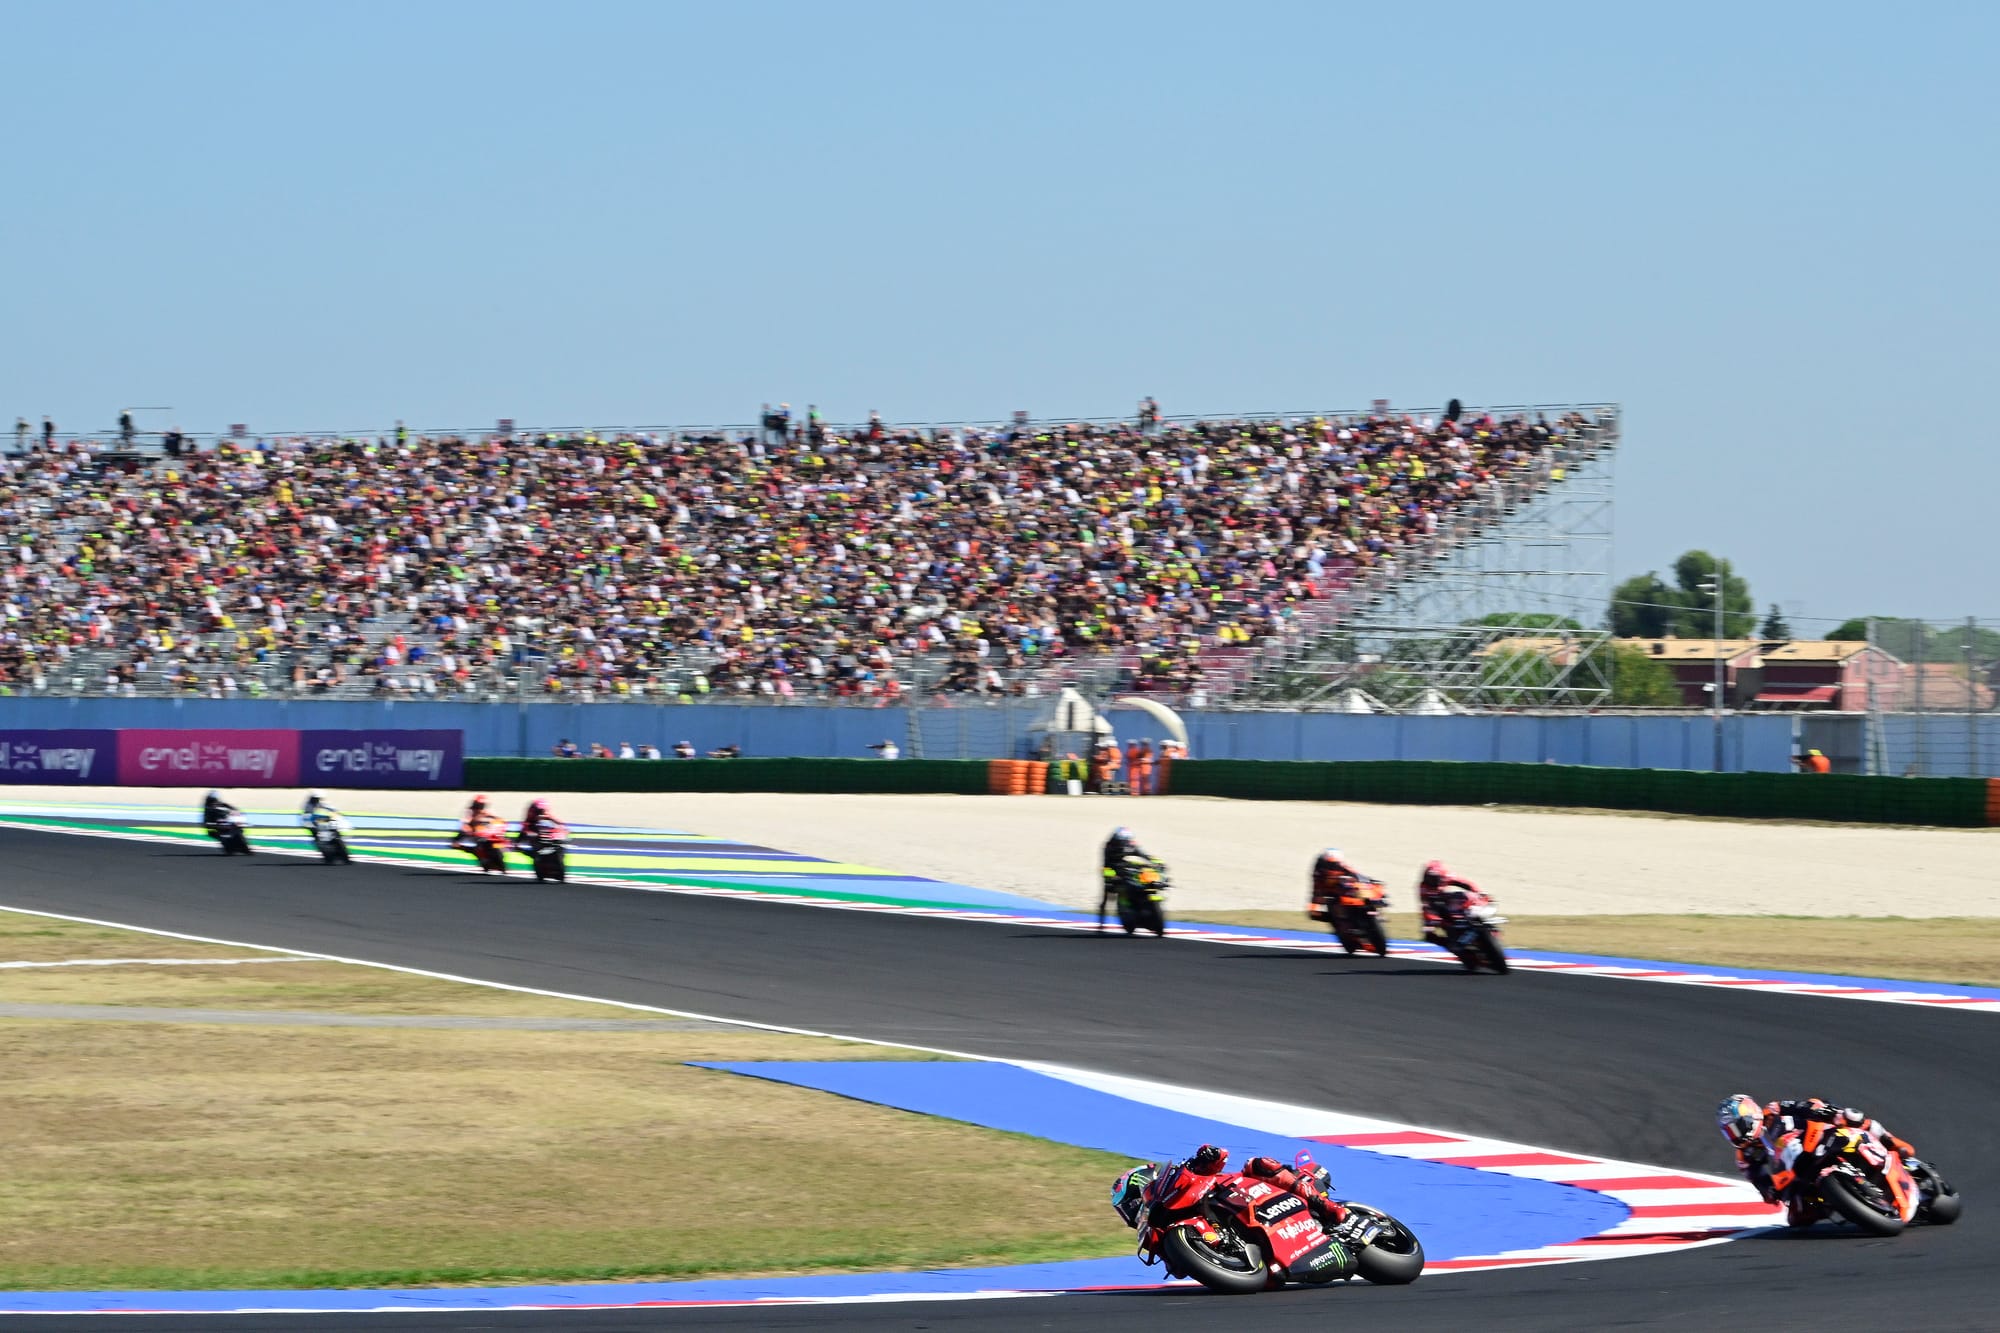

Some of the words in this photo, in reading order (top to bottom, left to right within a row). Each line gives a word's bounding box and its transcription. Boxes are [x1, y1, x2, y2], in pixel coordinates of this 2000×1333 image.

[40, 748, 95, 778] way
[139, 742, 201, 770] enel
[228, 748, 279, 779] way
[316, 742, 374, 771] enel
[396, 749, 445, 780] way
[1257, 1197, 1302, 1220] Lenovo
